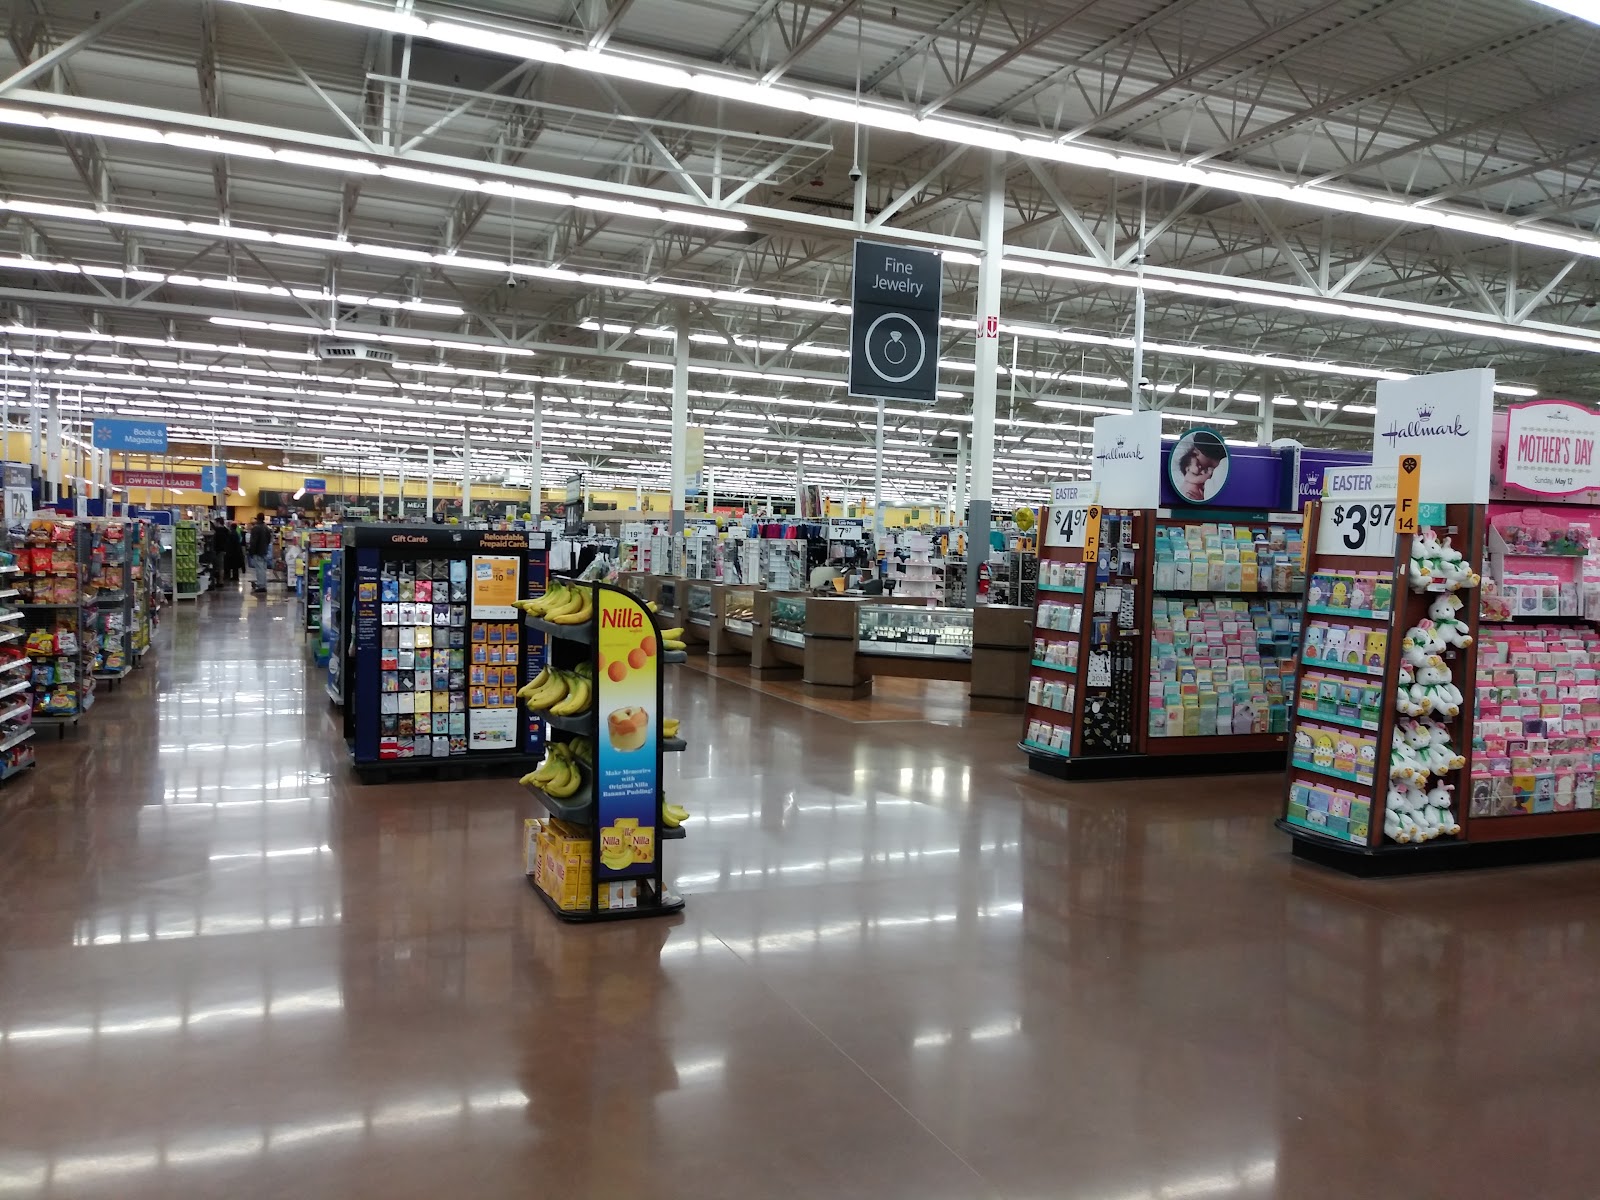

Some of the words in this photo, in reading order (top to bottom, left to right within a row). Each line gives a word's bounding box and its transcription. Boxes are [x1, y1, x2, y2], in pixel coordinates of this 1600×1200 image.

[885, 257, 913, 275] Fine
[872, 274, 924, 298] Jewelry
[133, 428, 157, 437] Books
[1381, 414, 1470, 448] Hallmark
[124, 435, 163, 446] Magazines
[1517, 434, 1571, 465] MOTHER'S
[1574, 438, 1594, 466] DAY
[1096, 444, 1145, 468] Hallmark
[1332, 474, 1373, 491] EASTER
[1534, 476, 1554, 485] Sunday,
[1554, 477, 1567, 486] May
[1567, 477, 1573, 485] 12
[1055, 487, 1078, 500] EASTER
[1402, 498, 1412, 512] F
[1398, 517, 1414, 530] 14
[391, 534, 406, 543] Gift
[406, 535, 429, 543] Cards
[484, 533, 524, 541] Reloadable
[1088, 537, 1095, 547] F
[479, 540, 508, 549] Prepaid
[1085, 551, 1095, 560] 12
[602, 608, 643, 628] Nilla
[608, 783, 634, 791] Original
[602, 836, 620, 846] Nilla
[632, 836, 650, 845] Nilla
